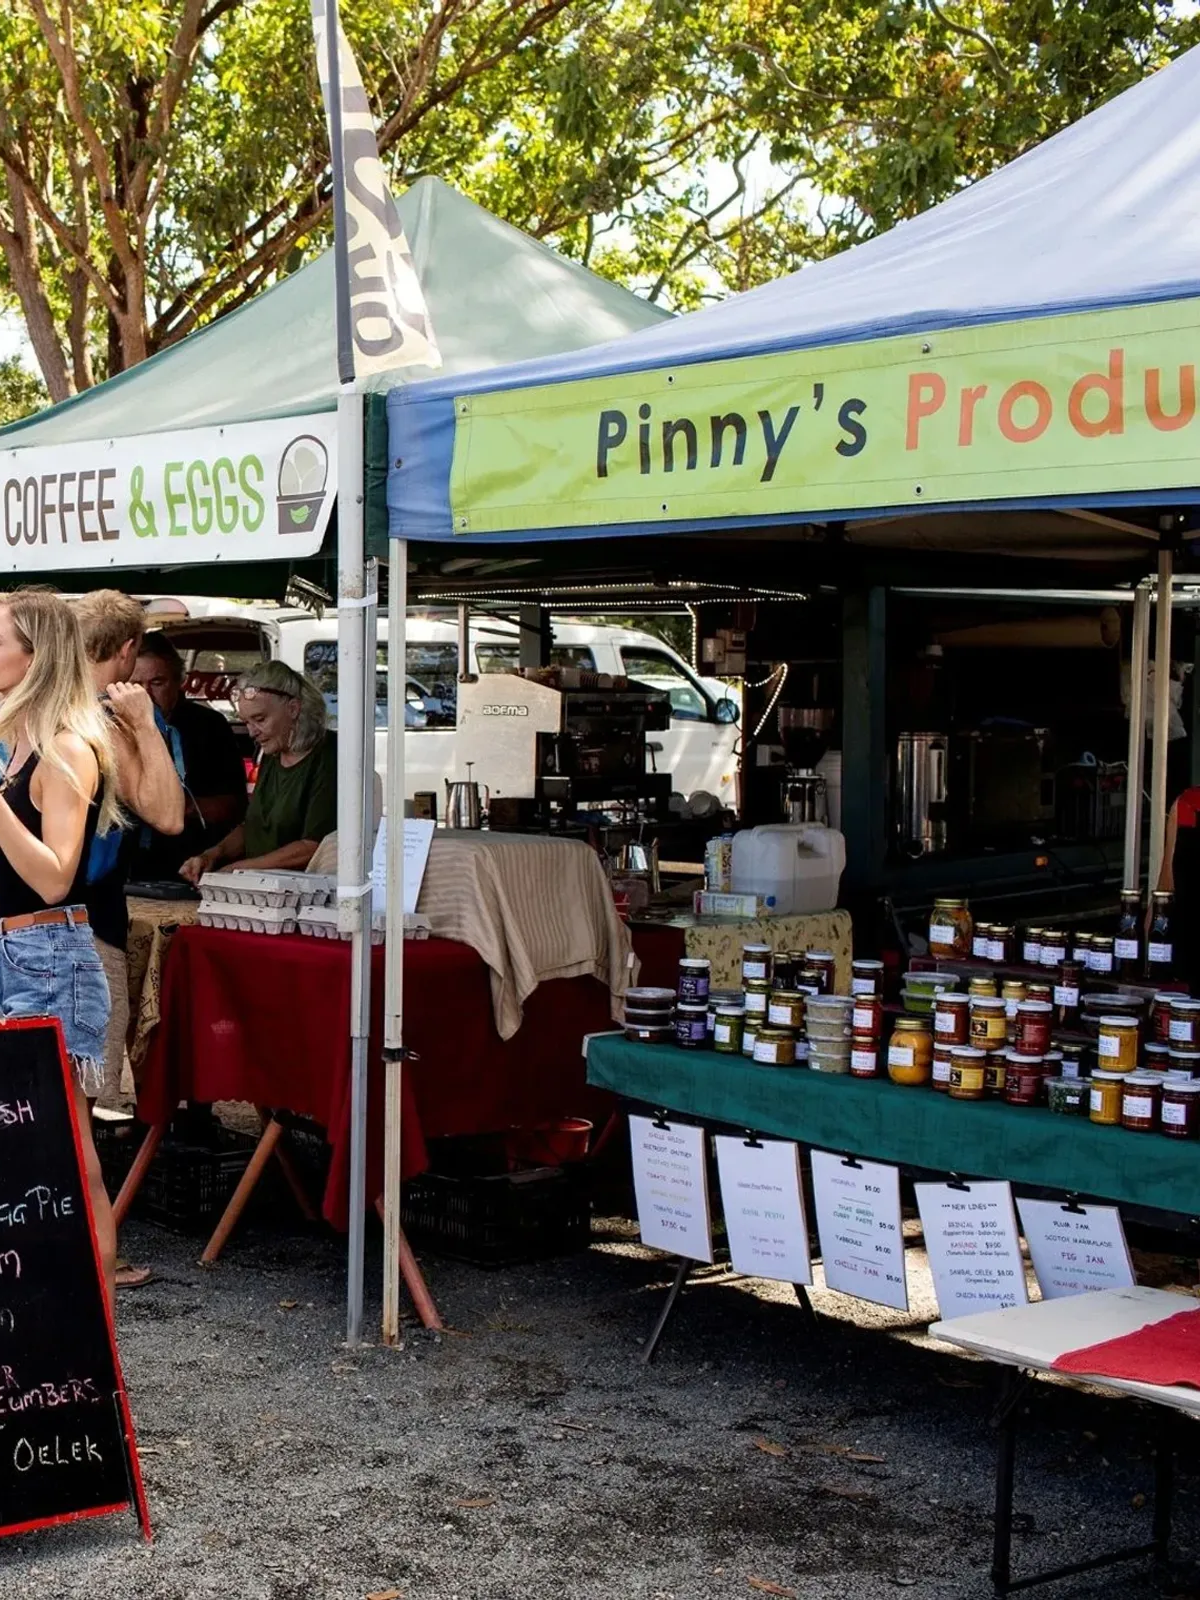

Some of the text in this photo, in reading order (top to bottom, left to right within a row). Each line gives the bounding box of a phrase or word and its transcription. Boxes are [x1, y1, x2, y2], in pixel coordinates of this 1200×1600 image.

[597, 382, 868, 481] Pinny's
[3, 468, 120, 545] COFFEE
[129, 464, 158, 538] &
[164, 454, 265, 536] EGGS
[1061, 1251, 1105, 1265] FIG JAM
